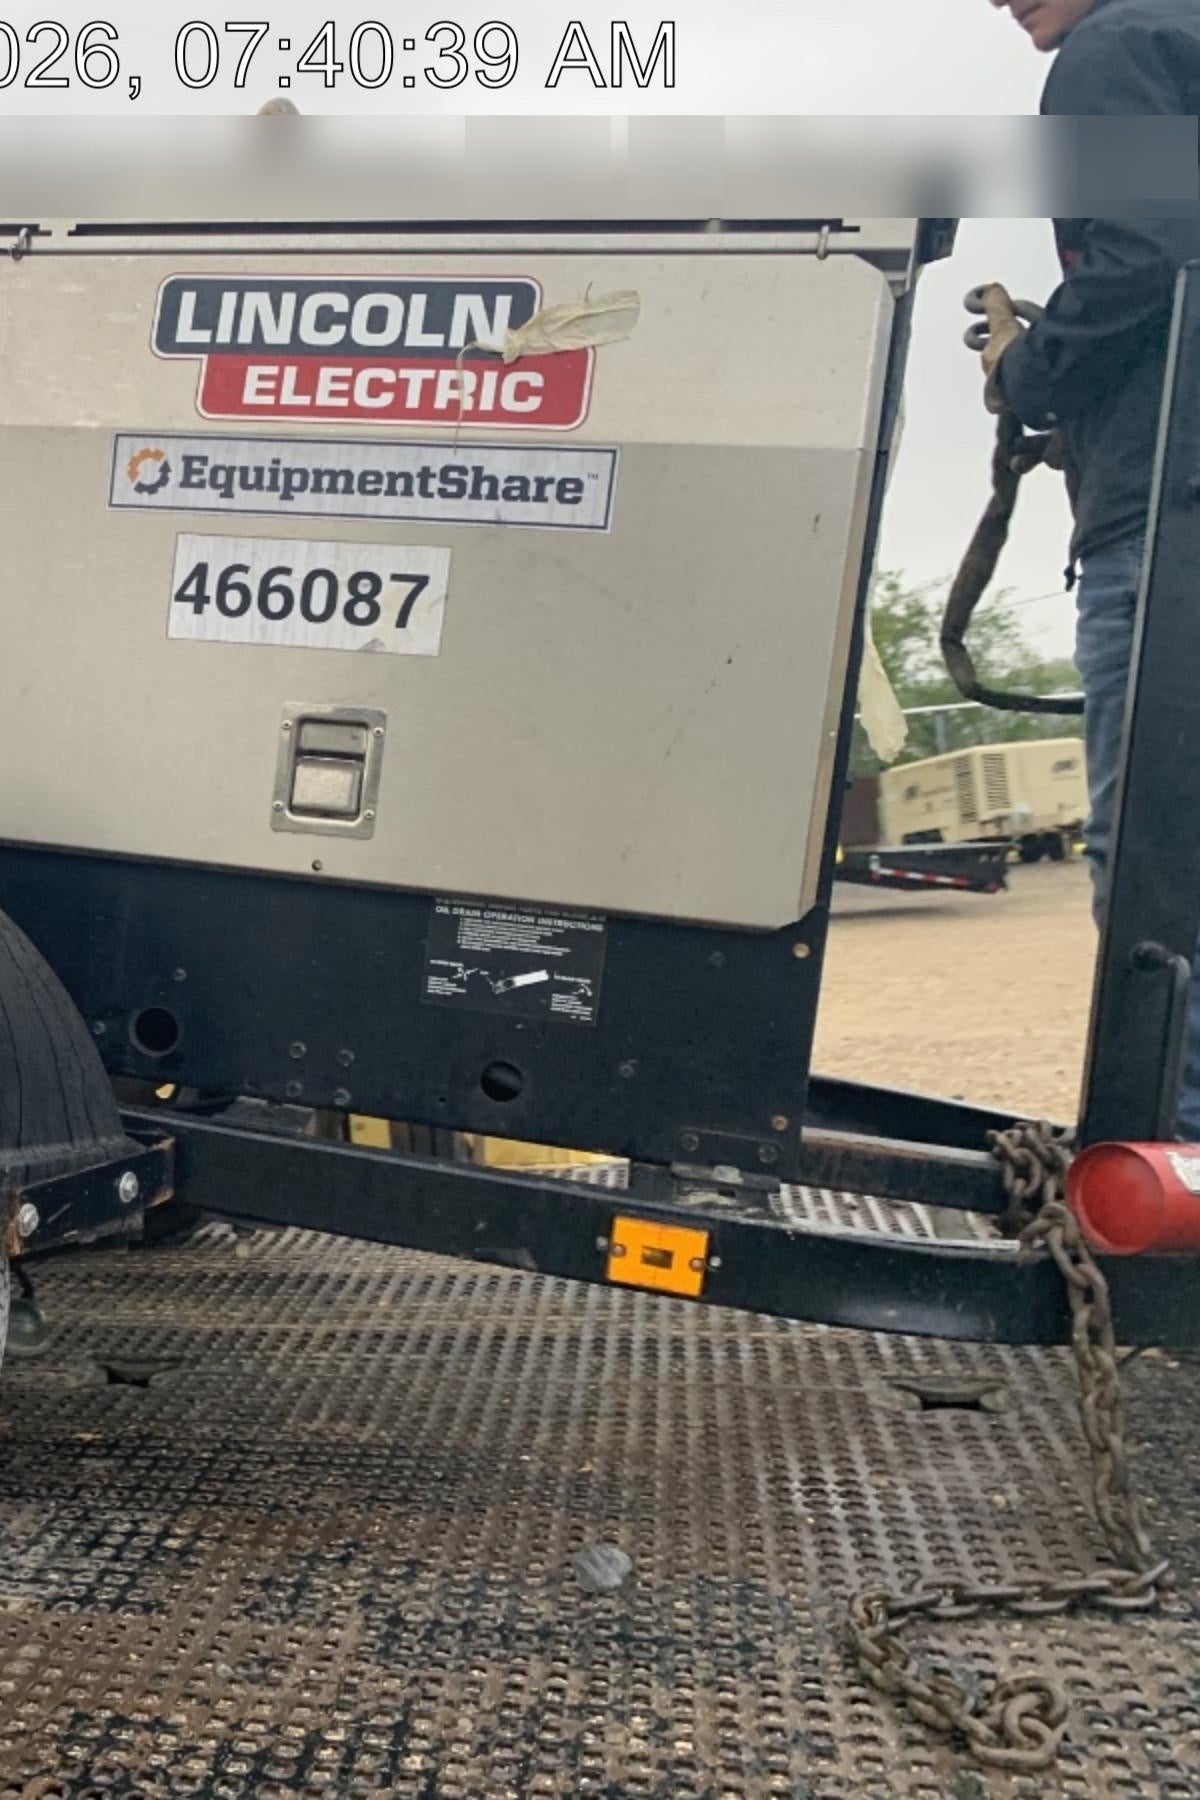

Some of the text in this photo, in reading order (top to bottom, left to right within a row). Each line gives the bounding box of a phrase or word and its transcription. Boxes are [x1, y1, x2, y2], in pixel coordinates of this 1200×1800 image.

[175, 291, 513, 351] LINCOLN
[242, 365, 545, 413] ELECTRIC
[173, 561, 430, 629] 466087
[483, 910, 536, 924] OPERATION
[537, 917, 604, 932] INSTRUCTIONS
